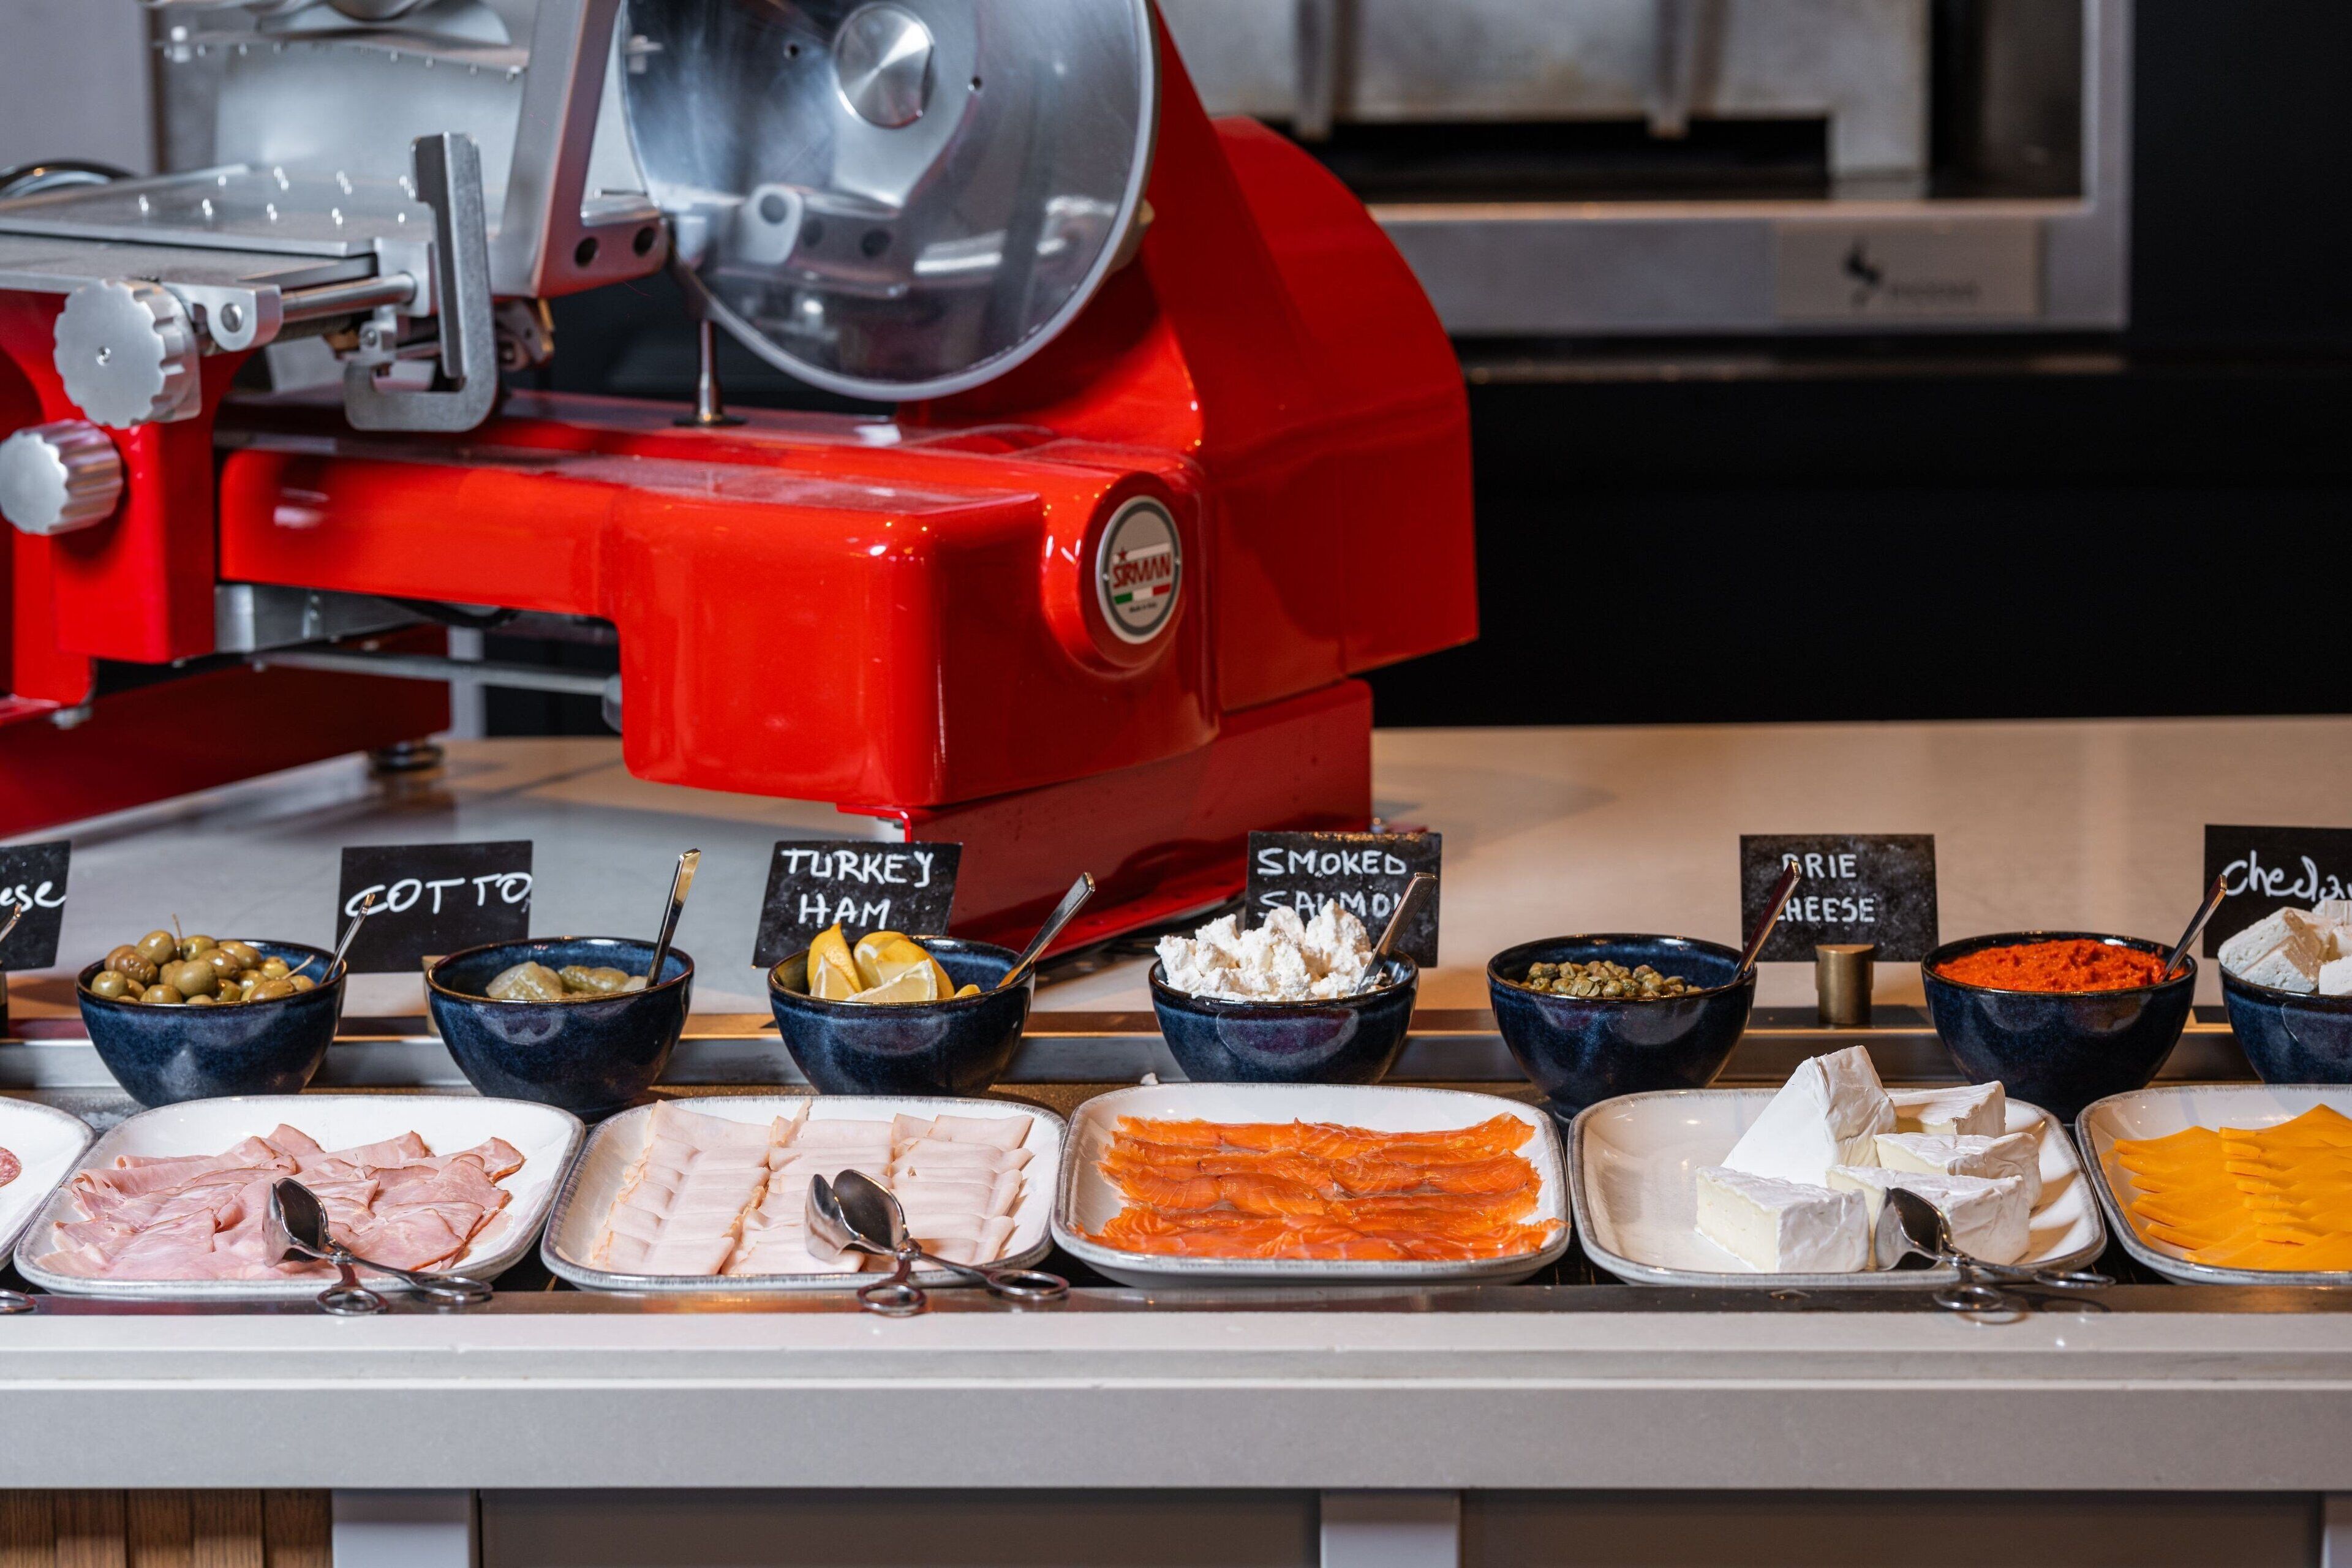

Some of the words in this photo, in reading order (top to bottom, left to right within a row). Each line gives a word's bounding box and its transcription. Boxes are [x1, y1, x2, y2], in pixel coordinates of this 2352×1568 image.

[1113, 552, 1170, 589] SIRMAN
[780, 848, 934, 888] TURKEY
[1257, 847, 1407, 875] SMOKED
[344, 872, 532, 917] COTTO
[798, 893, 891, 930] HAM
[1257, 890, 1402, 919] SALMO
[1776, 895, 1875, 922] HEESE
